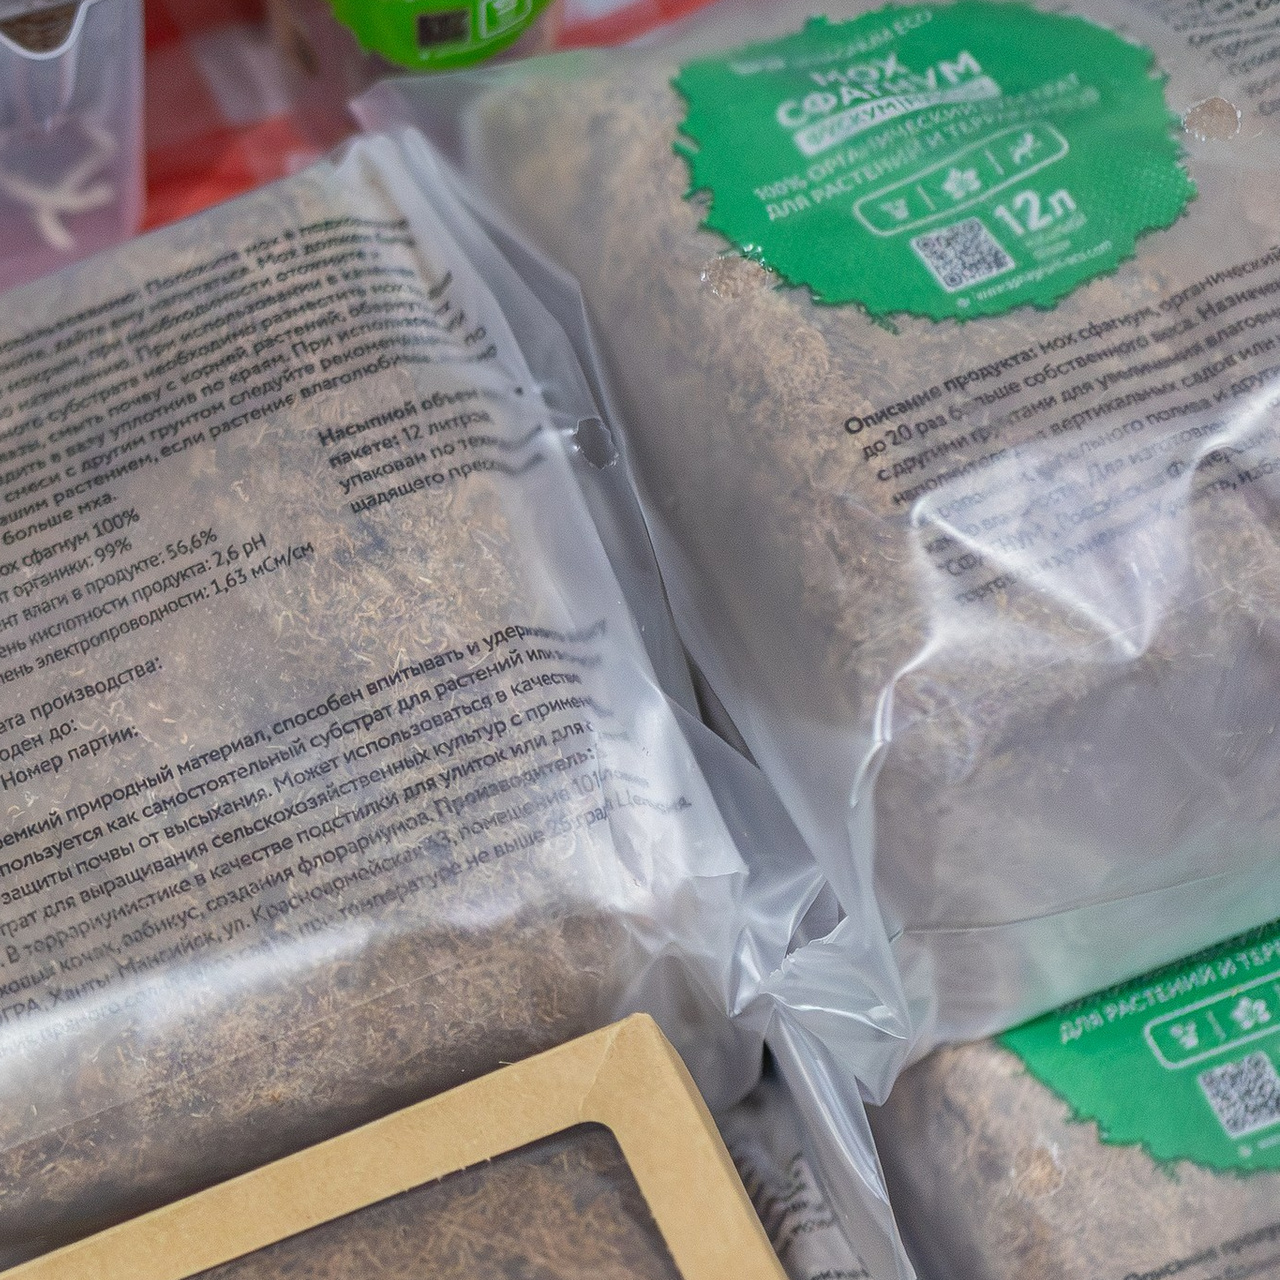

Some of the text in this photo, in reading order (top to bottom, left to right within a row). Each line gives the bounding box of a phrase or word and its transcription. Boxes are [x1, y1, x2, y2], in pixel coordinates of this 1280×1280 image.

[994, 187, 1078, 237] 12л
[317, 399, 417, 445] Насыпной
[328, 423, 423, 468] пакете: 12
[51, 451, 158, 506] растением,
[159, 429, 205, 457] если
[338, 441, 456, 494] упакован по
[350, 470, 445, 515] щадящего
[0, 507, 73, 545] больше
[75, 491, 116, 515] мха.
[20, 530, 91, 568] сфагнум
[91, 506, 140, 538] 100%
[11, 555, 93, 597] органики:
[93, 536, 133, 563] 99%
[21, 592, 69, 620] влаги
[70, 586, 83, 599] в
[84, 552, 165, 594] продукте:
[165, 527, 218, 560] 56,6%
[27, 594, 129, 644] кислотности
[130, 559, 212, 601] продукта:
[210, 543, 240, 567] 2,6
[241, 532, 267, 560] pH
[35, 586, 210, 668] электропроводности:
[209, 567, 248, 594] 1,63
[250, 543, 315, 578] мСм/см
[30, 657, 163, 721] производства:
[0, 724, 138, 789] Номер партии:
[46, 720, 78, 744] до:
[65, 762, 174, 821] природный
[175, 728, 272, 776] материал,
[270, 687, 364, 735] способен
[365, 646, 464, 696] впитывать
[105, 809, 140, 833] как
[140, 736, 305, 818] самостоятельный
[309, 703, 396, 749] субстрат
[394, 688, 431, 716] для
[434, 646, 524, 701] растений
[0, 866, 73, 906] защиты
[75, 841, 135, 875] почвы
[137, 831, 159, 849] от
[162, 786, 272, 839] высыхания.
[272, 756, 340, 793] Может
[342, 694, 493, 765] использоваться
[78, 718, 509, 903] выращивания сельскохозяйственных культур
[296, 792, 399, 844] подстилки
[400, 776, 438, 804] для
[440, 748, 507, 790] улиток
